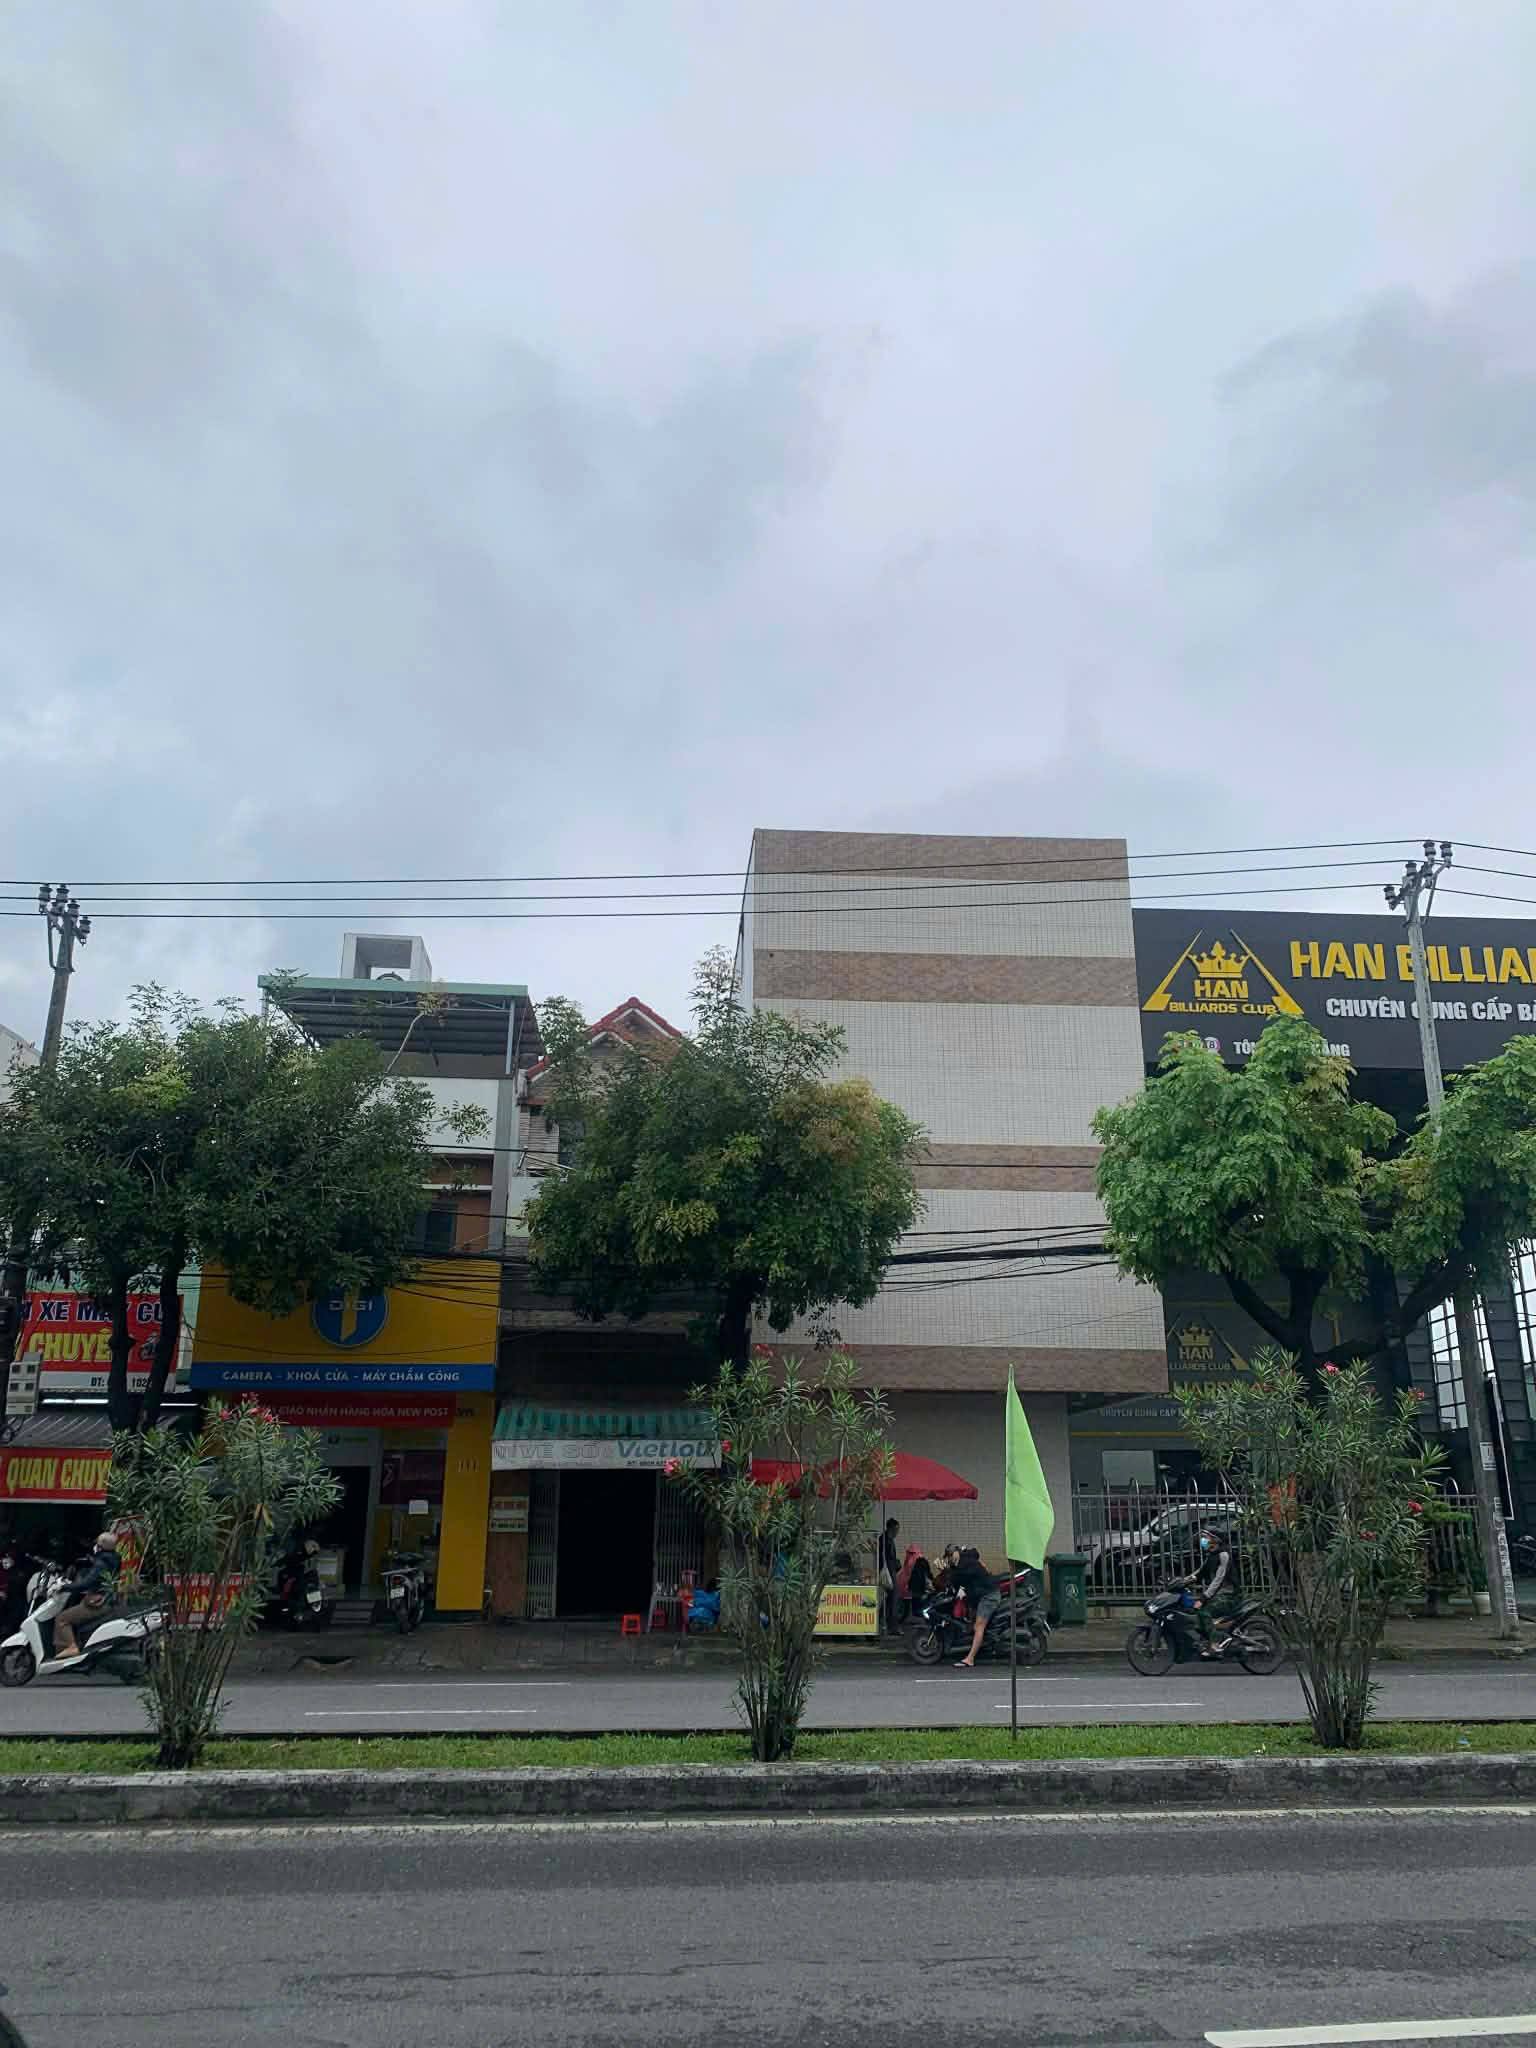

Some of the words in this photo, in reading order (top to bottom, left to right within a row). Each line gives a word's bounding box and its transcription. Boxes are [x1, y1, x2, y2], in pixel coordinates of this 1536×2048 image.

[1290, 941, 1386, 979] HAN
[1195, 979, 1248, 998] HAN
[1169, 1002, 1238, 1014] BILLIARDS
[1242, 1003, 1277, 1015] CLUB
[1326, 997, 1406, 1018] CHUYÊN
[1472, 996, 1513, 1020] CẤP
[40, 1302, 70, 1321] XE
[1179, 1347, 1214, 1360] HAN
[223, 1371, 273, 1380] CAMERA
[362, 1369, 385, 1381] MÁY
[428, 1369, 460, 1381] CÔNG
[424, 1407, 449, 1417] POST
